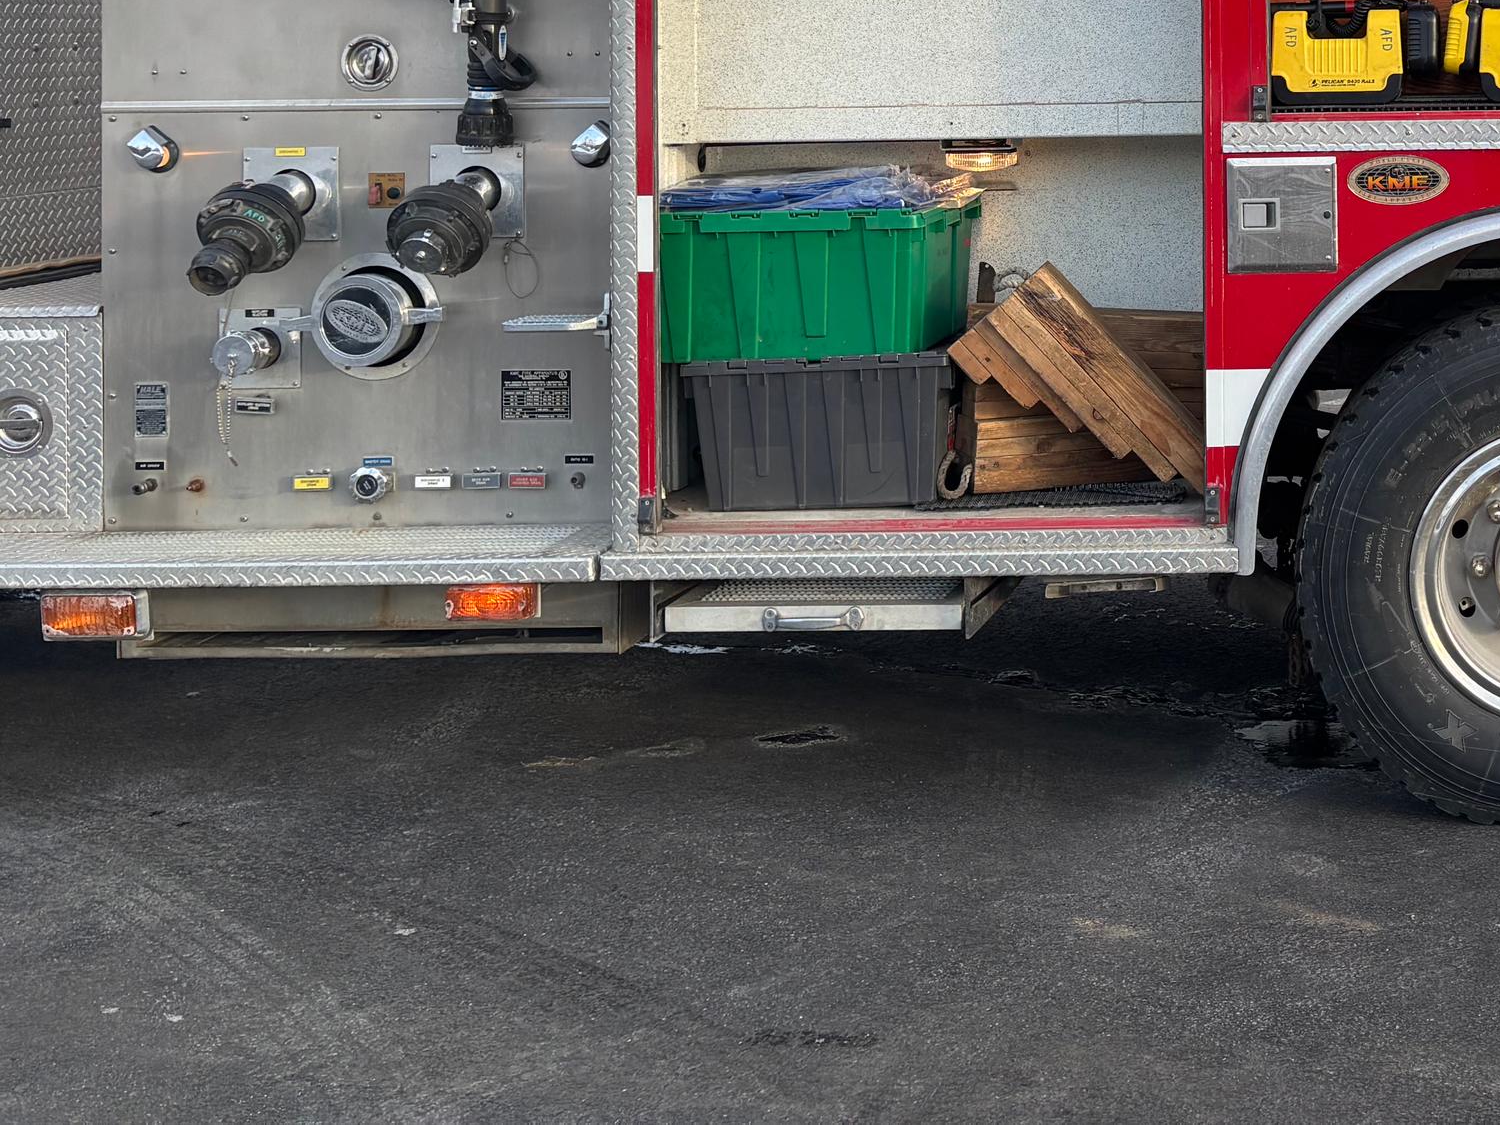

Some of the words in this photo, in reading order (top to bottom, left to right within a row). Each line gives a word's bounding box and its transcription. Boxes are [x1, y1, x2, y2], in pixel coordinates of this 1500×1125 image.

[1284, 27, 1297, 47] AFD
[1380, 29, 1392, 51] AFD
[1367, 175, 1429, 191] KME
